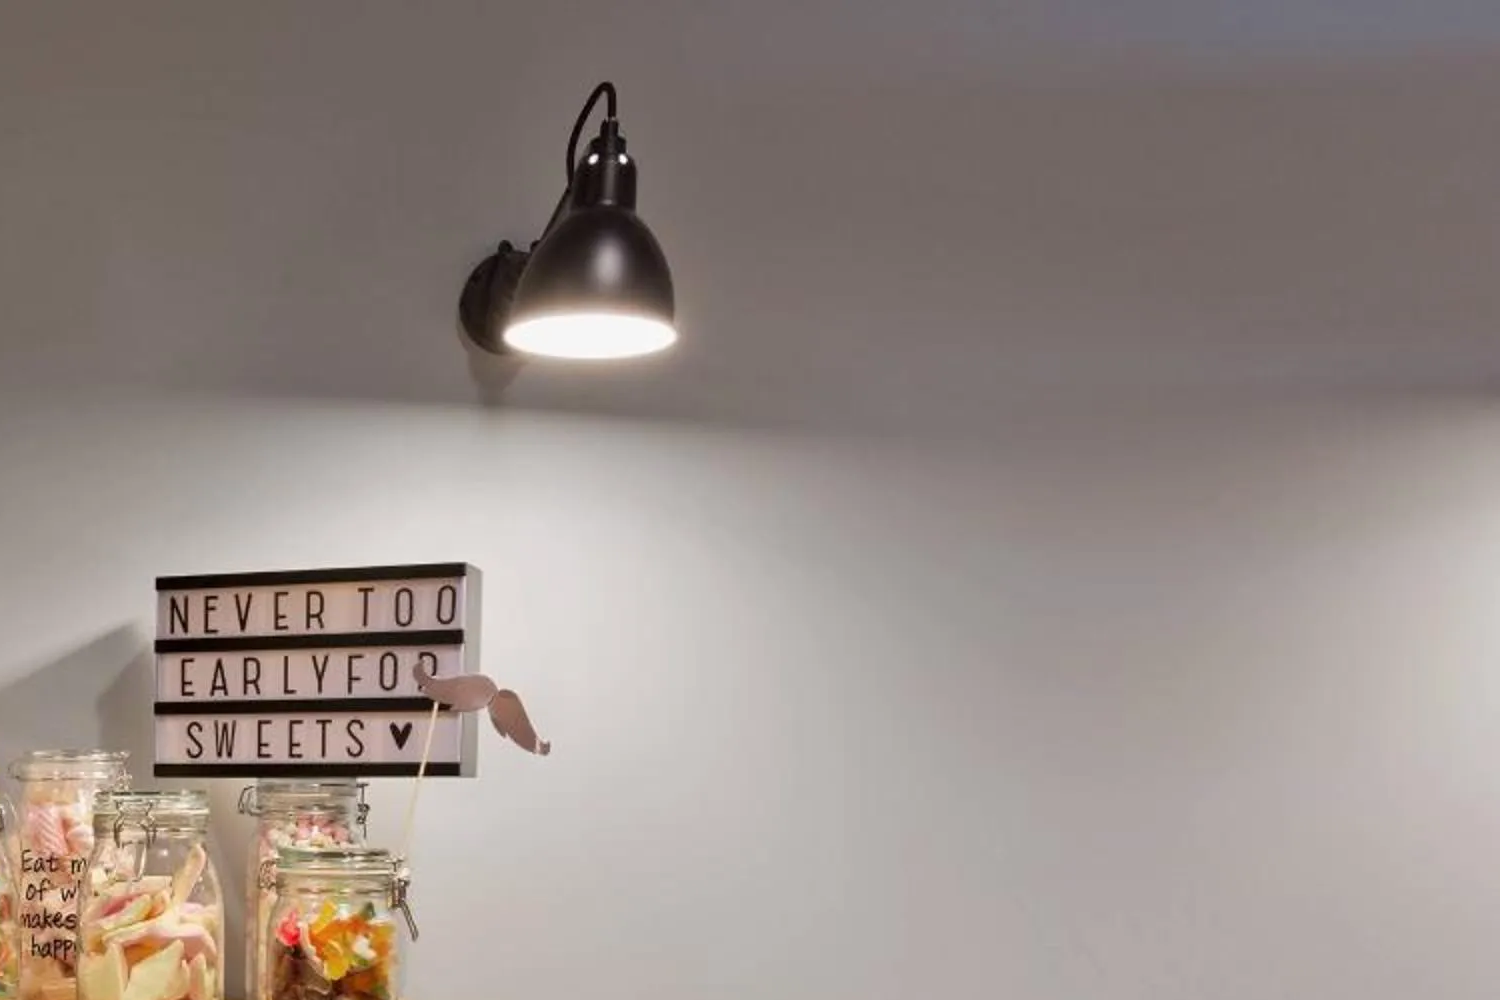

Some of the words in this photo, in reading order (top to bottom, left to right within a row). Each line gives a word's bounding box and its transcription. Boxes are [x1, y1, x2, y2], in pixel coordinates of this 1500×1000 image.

[169, 591, 325, 634] NEVER
[358, 585, 457, 627] TOO
[186, 719, 366, 759] SWEETS
[21, 849, 59, 872] Eat
[26, 878, 51, 902] of
